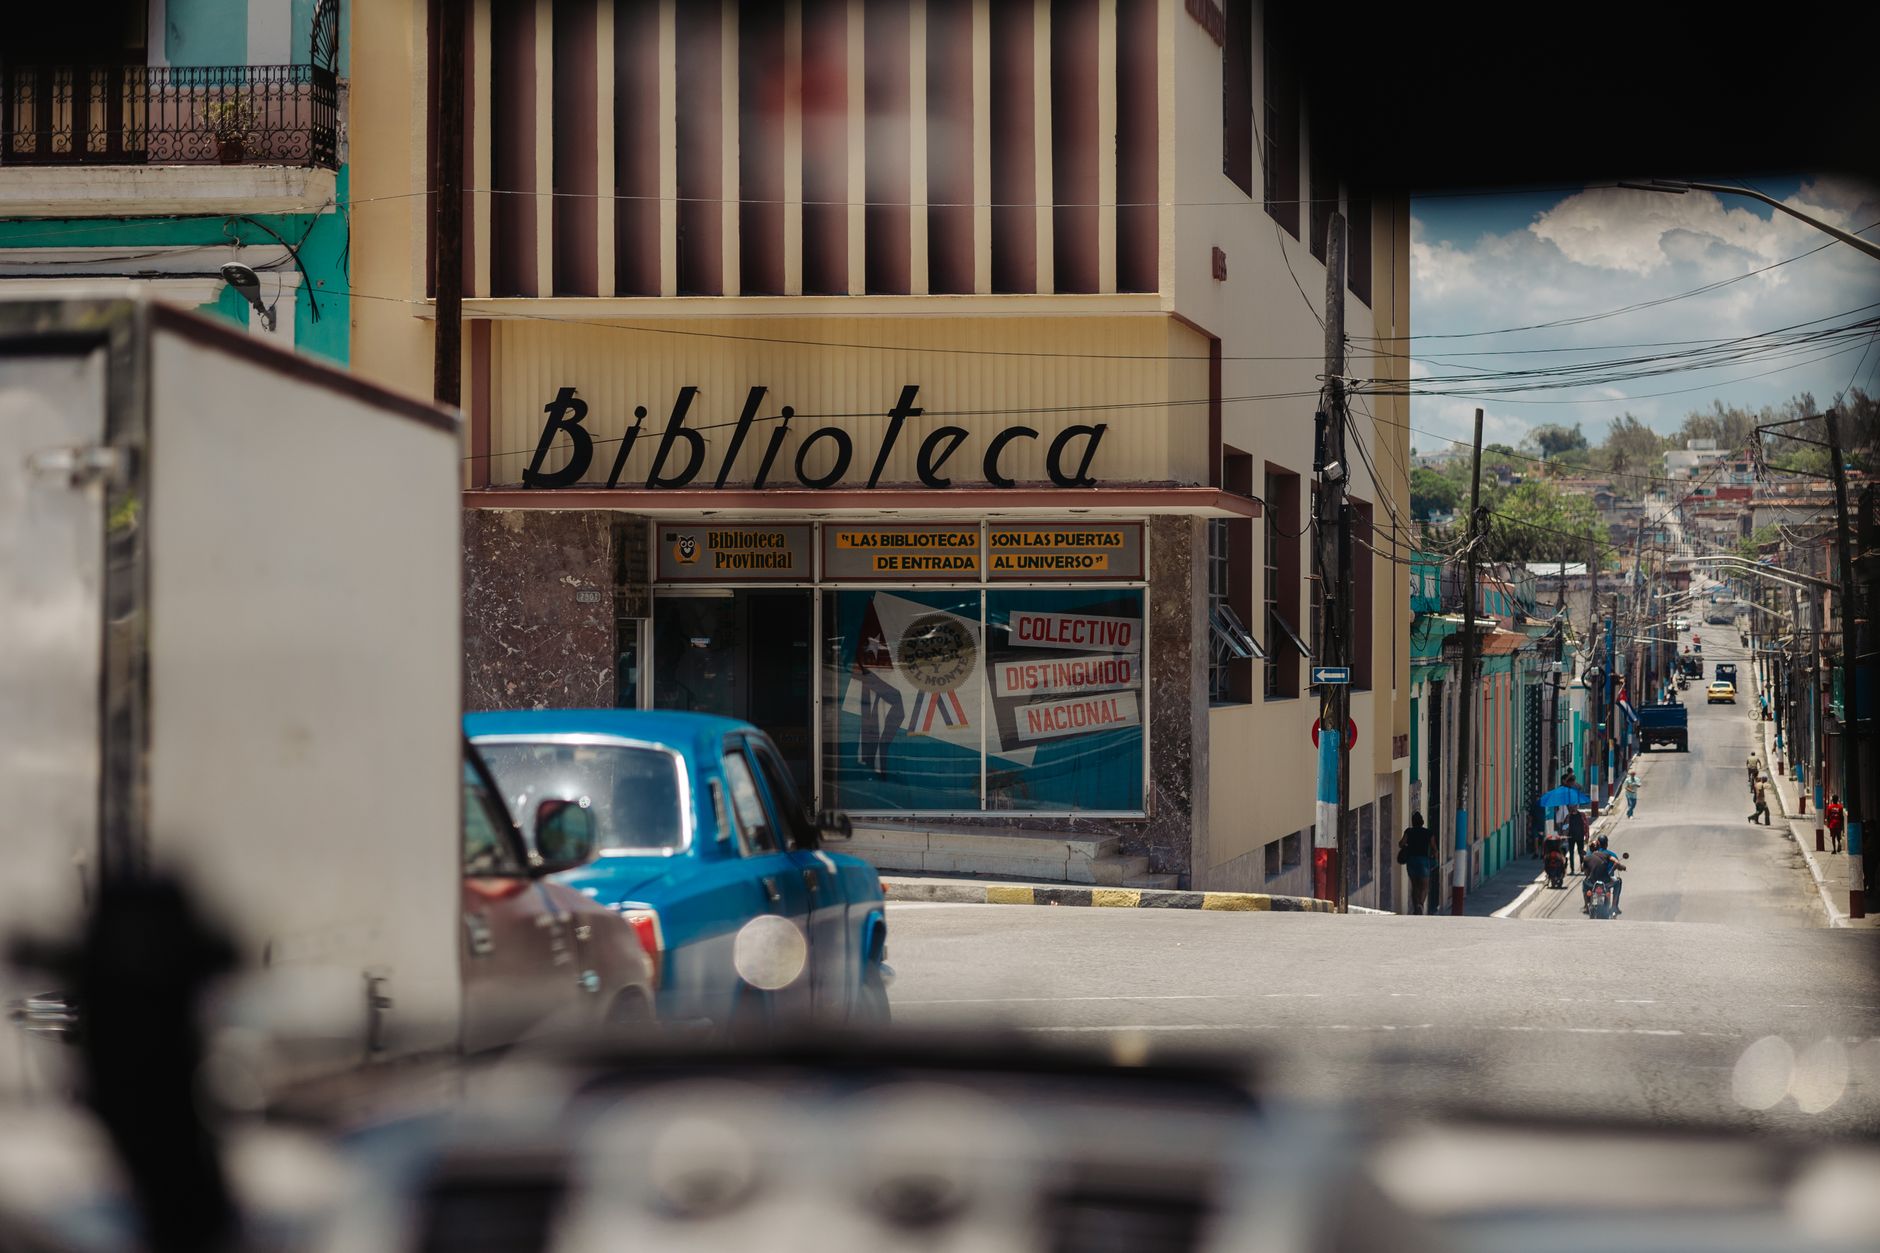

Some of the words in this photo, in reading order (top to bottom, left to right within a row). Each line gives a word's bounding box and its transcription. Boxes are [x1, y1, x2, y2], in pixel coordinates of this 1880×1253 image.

[522, 385, 1107, 490] Biblioteca
[708, 532, 785, 549] Biblioteca
[880, 534, 975, 547] BIBLIOTECAS
[991, 533, 1021, 546] SON
[1024, 533, 1050, 546] LAS
[1054, 533, 1120, 546] PUERTAS
[715, 551, 792, 569] Provincial
[877, 557, 898, 569] DE
[902, 557, 975, 569] ENTRADA
[994, 556, 1014, 569] AL
[1019, 616, 1131, 647] COLECTIVO
[925, 655, 969, 687] MONTE
[931, 663, 942, 674] Y
[1006, 659, 1131, 691] DISTINGUIDO
[1027, 698, 1126, 734] NACIONAL
